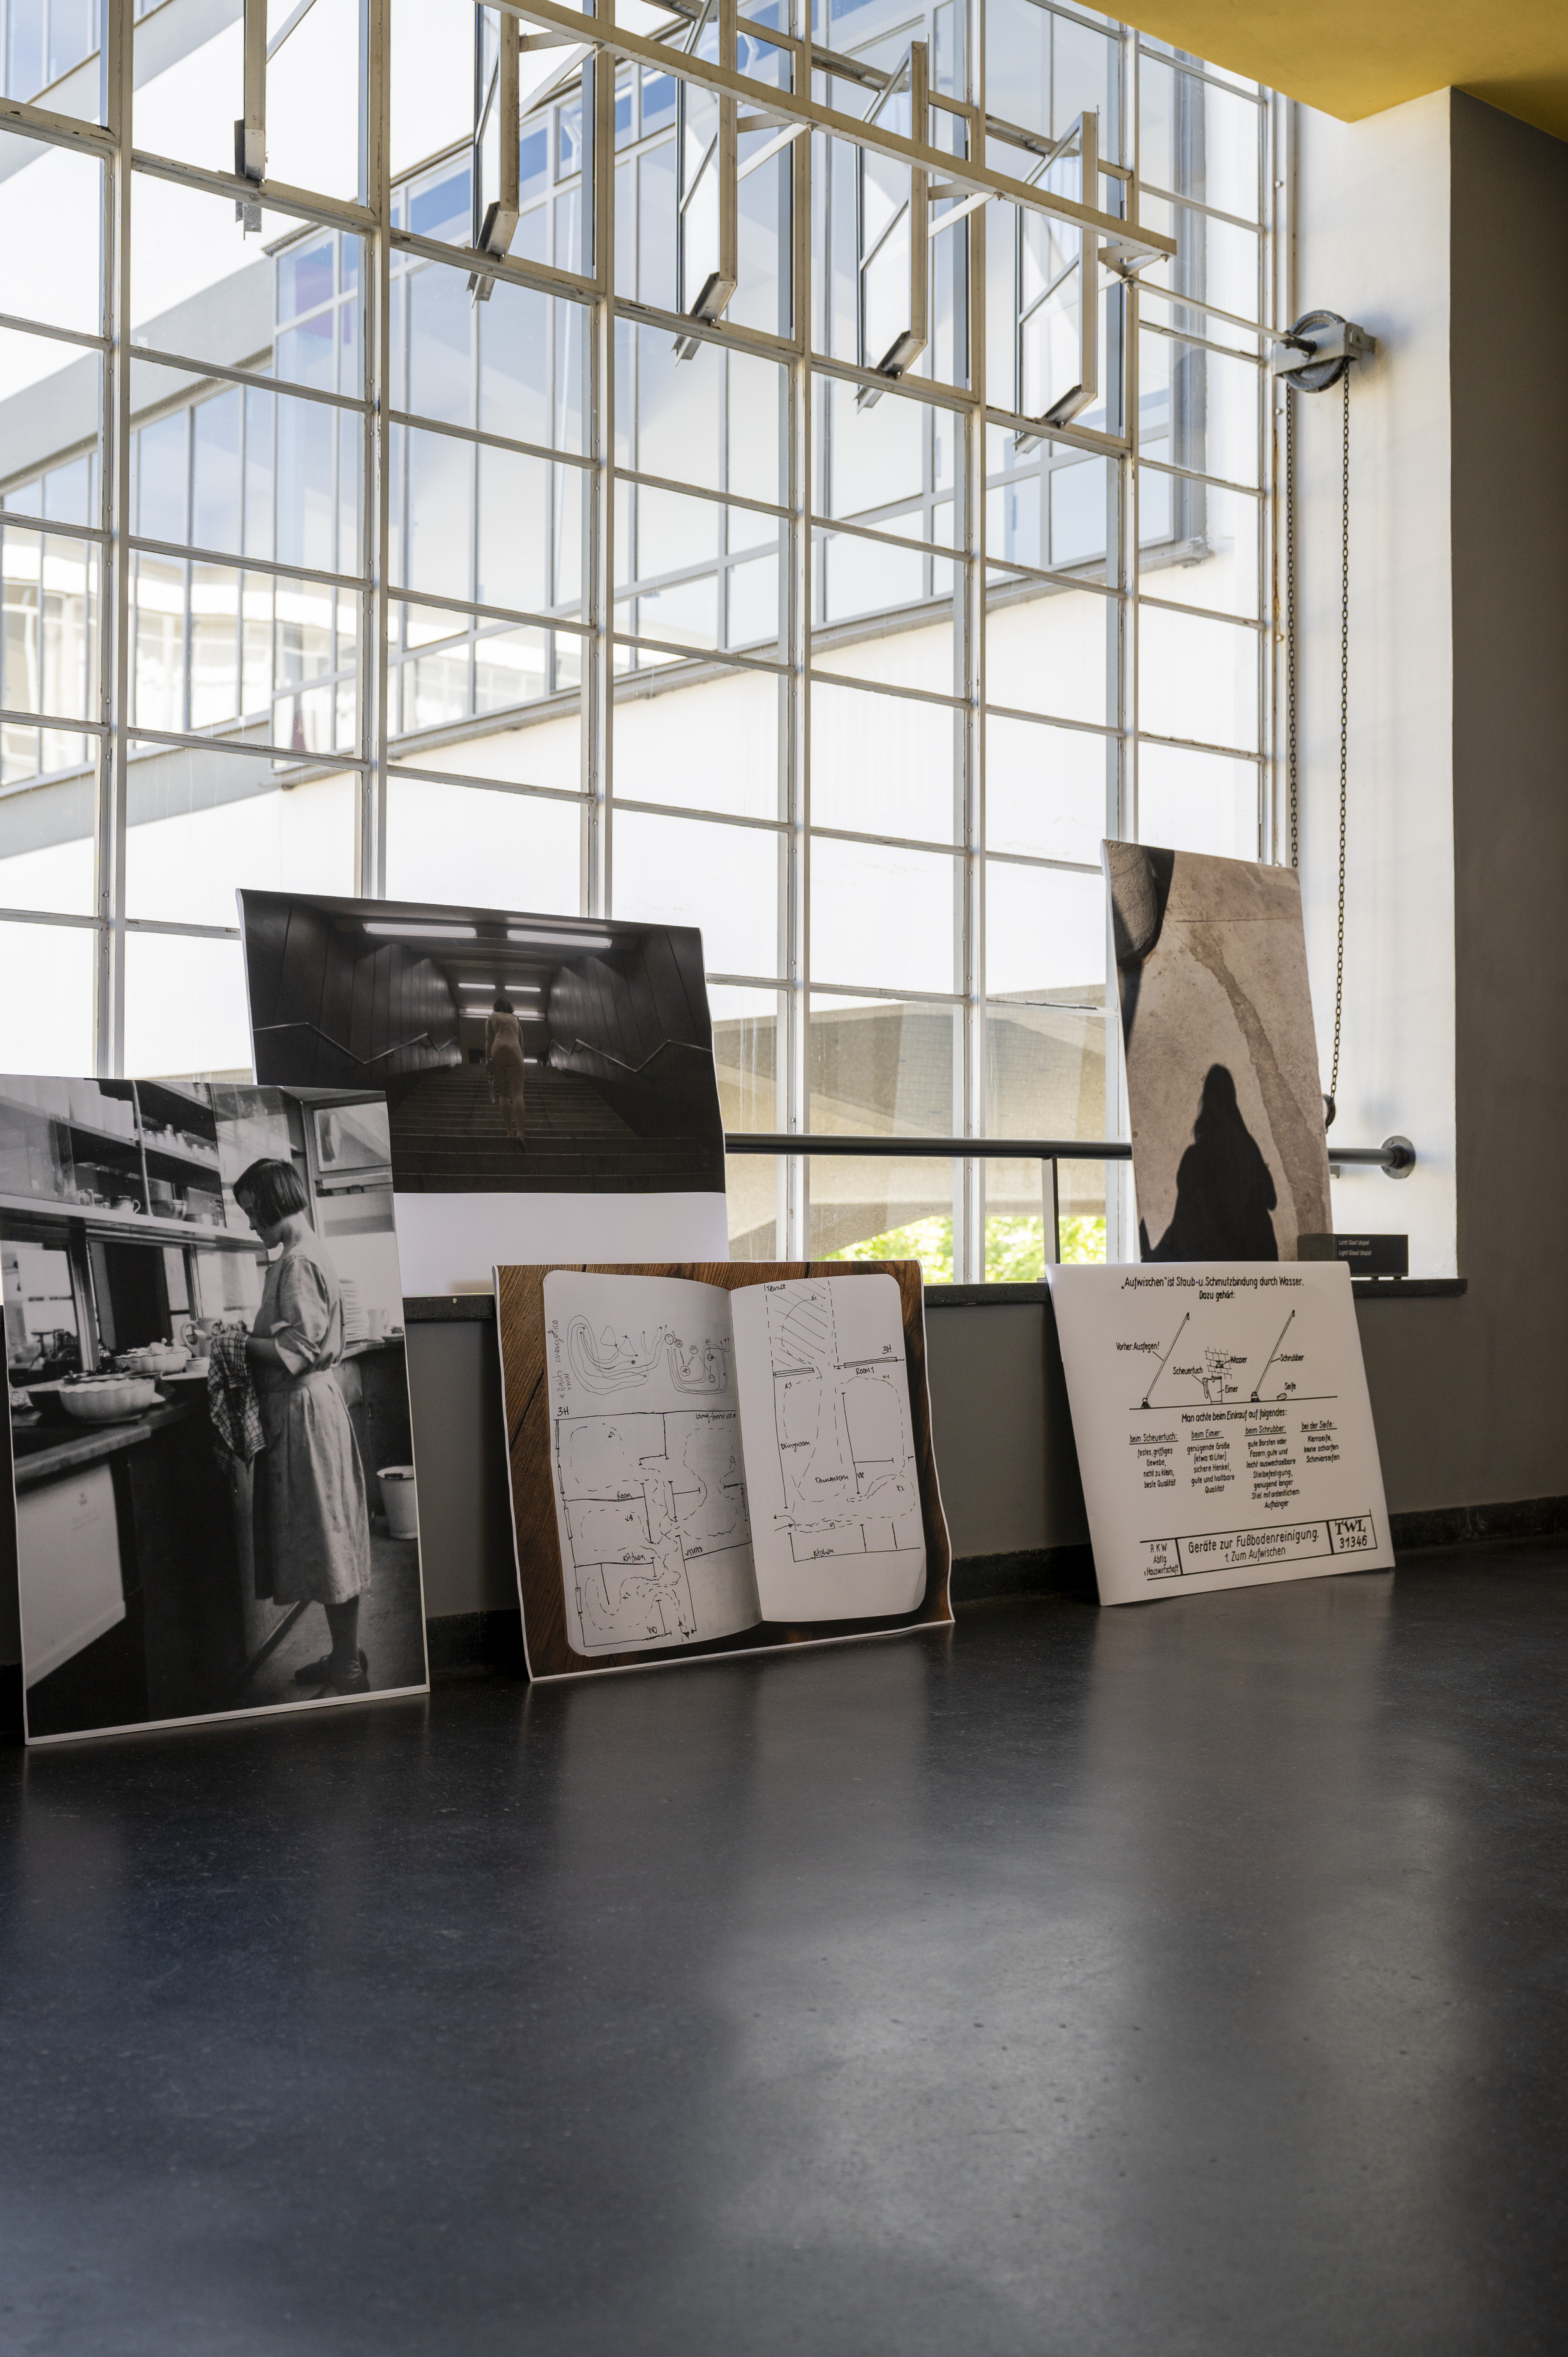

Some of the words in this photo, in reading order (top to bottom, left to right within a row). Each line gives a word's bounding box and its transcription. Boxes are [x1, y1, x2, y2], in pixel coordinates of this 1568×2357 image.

[1260, 1276, 1278, 1286] durch
[1280, 1276, 1304, 1286] Wasser.
[1199, 1290, 1214, 1300] Dazu
[1216, 1290, 1235, 1302] gehört:
[1173, 1366, 1203, 1375] Scheuertuch
[1225, 1385, 1238, 1393] Eimer
[1285, 1382, 1296, 1392] Seife
[1181, 1413, 1195, 1423] Man
[1196, 1412, 1211, 1422] achte
[1213, 1411, 1226, 1421] beim
[1227, 1410, 1247, 1422] Einkauf
[1249, 1410, 1258, 1421] auf
[1259, 1408, 1287, 1421] folgendes:
[1259, 1425, 1286, 1433] Schrubber:
[1319, 1420, 1334, 1430] Seife:
[1130, 1434, 1141, 1442] beim
[1143, 1432, 1178, 1442] Scheuertuch:
[1191, 1430, 1204, 1438] beim
[1308, 1434, 1332, 1442] Kernseife,
[1187, 1444, 1214, 1455] genügende
[1216, 1442, 1230, 1450] Größe
[1248, 1440, 1257, 1449] gute
[1259, 1438, 1275, 1447] Borsten
[1194, 1453, 1208, 1464] (etwa
[1214, 1451, 1227, 1461] Liter)
[1259, 1458, 1296, 1467] auswechselbare
[1306, 1454, 1340, 1463] Schmierseifen
[1146, 1459, 1166, 1467] Gewebe,
[1194, 1465, 1211, 1473] sichere
[1213, 1463, 1231, 1472] Henkel,
[1161, 1468, 1174, 1477] klein,
[1253, 1470, 1293, 1479] Stielbefestigung,
[1157, 1479, 1176, 1488] Qualität
[1191, 1476, 1202, 1487] gute
[1254, 1481, 1277, 1491] genügend
[1278, 1479, 1293, 1488] langer
[1205, 1485, 1224, 1493] Qualität
[1271, 1489, 1300, 1498] ordentlichem
[1264, 1500, 1289, 1510] Aufhänger
[1335, 1519, 1366, 1535] TWL
[1188, 1539, 1217, 1554] Geräte
[1220, 1539, 1233, 1550] zur
[1236, 1528, 1319, 1548] Fußbodenreinigung.
[1340, 1535, 1368, 1549] 31346
[1231, 1551, 1247, 1562] Zum
[1248, 1547, 1286, 1562] Aufwischen
